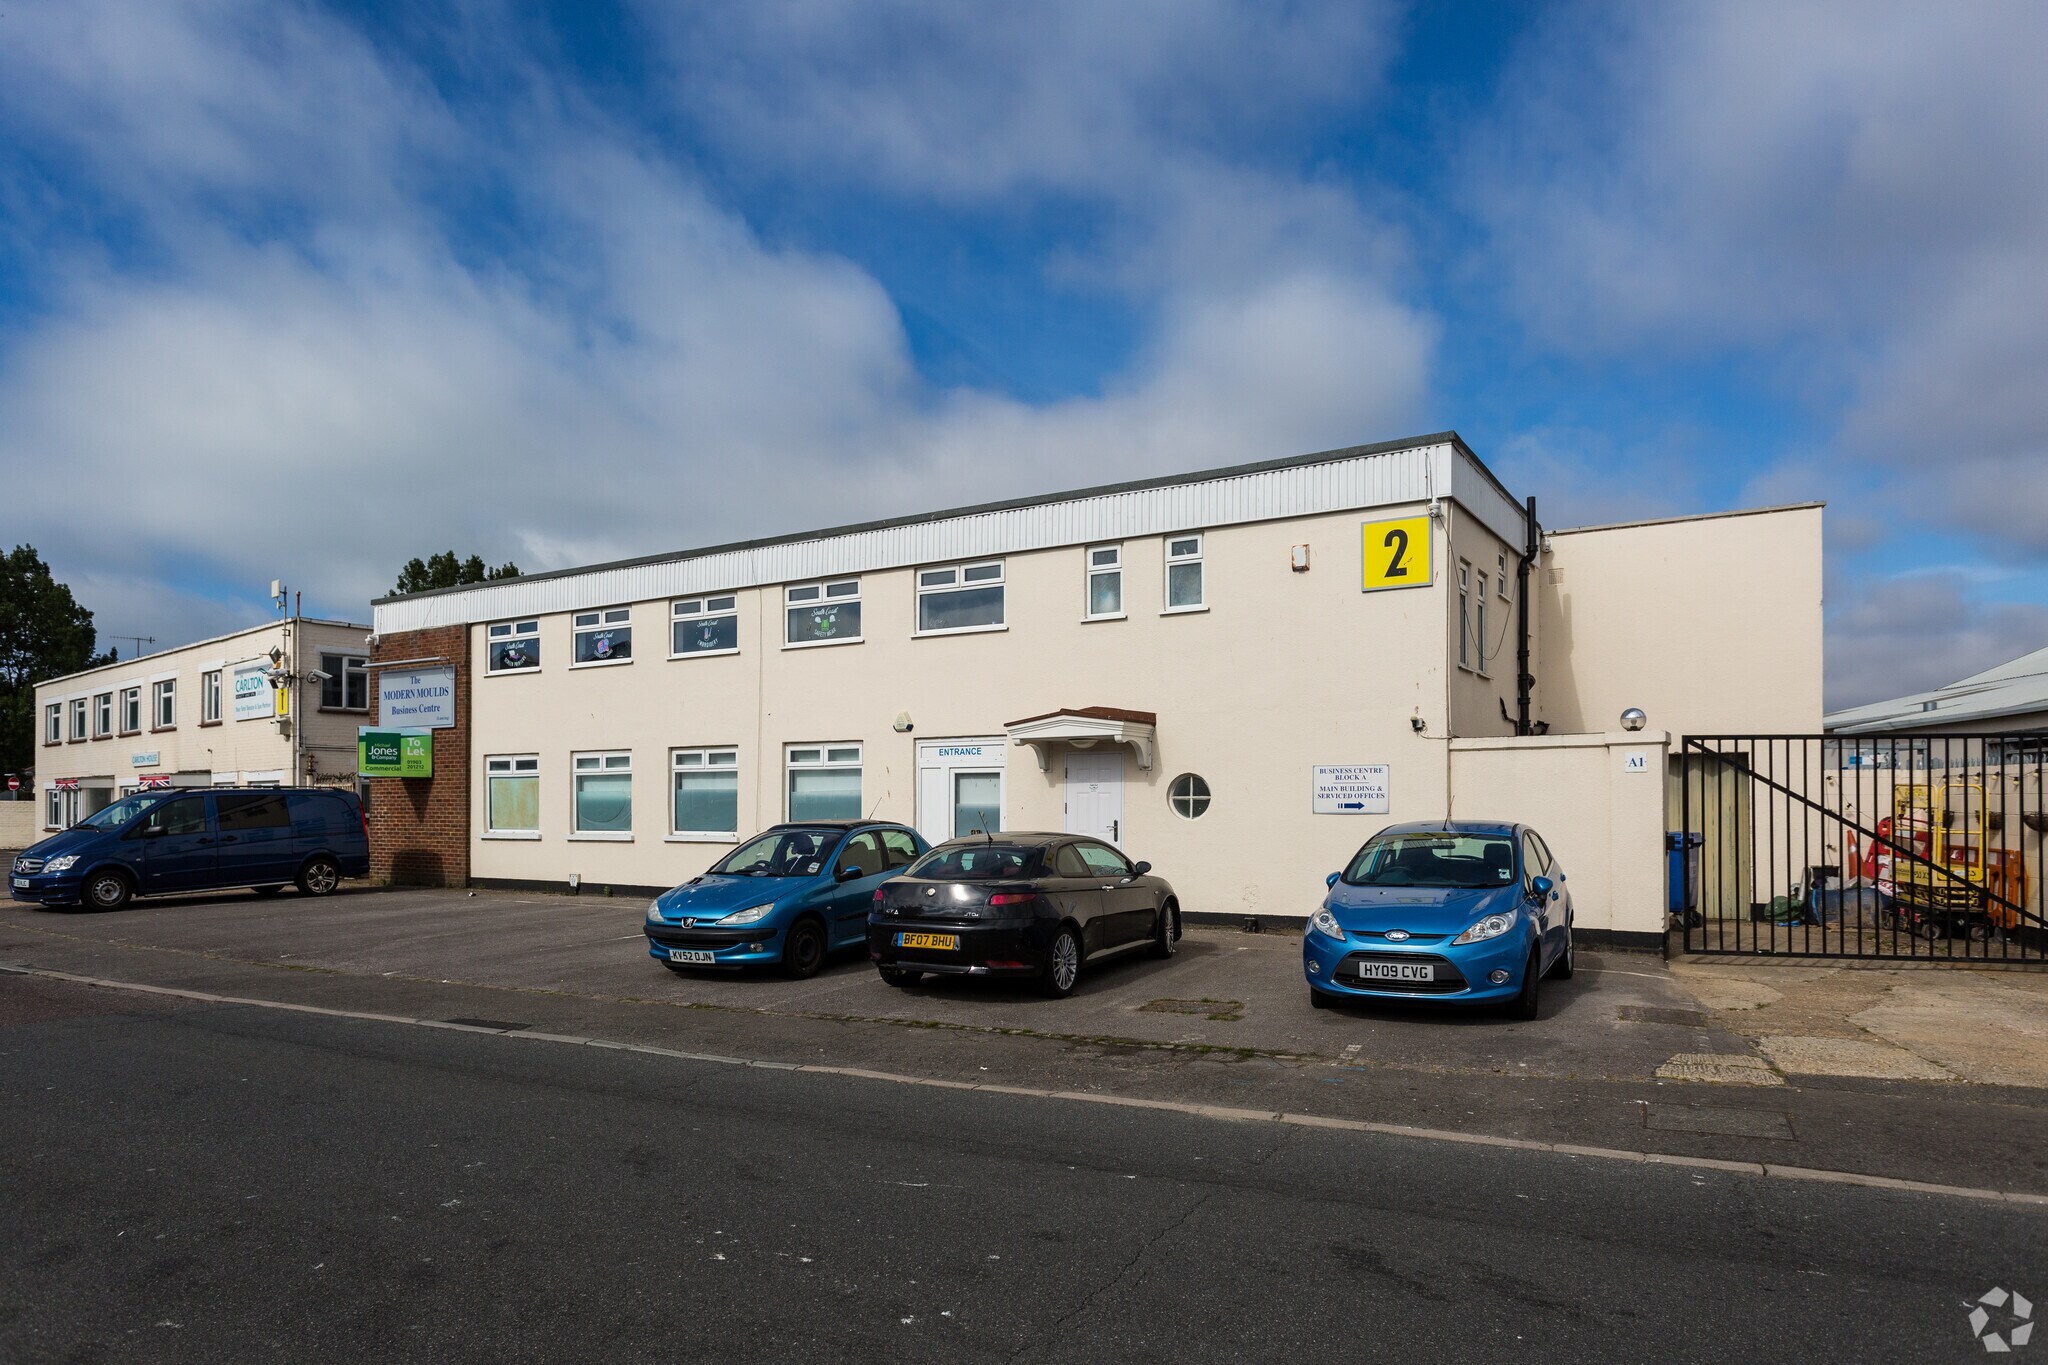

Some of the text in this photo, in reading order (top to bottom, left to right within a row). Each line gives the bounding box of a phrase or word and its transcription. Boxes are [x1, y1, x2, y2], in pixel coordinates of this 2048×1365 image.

[1384, 529, 1408, 578] 2
[236, 676, 264, 692] CARLTON
[410, 676, 421, 684] The
[384, 687, 449, 700] MODERN MOULDS
[392, 704, 440, 715] Business Centre
[406, 738, 420, 746] To
[368, 746, 398, 755] Jones
[407, 747, 425, 756] Let
[939, 747, 982, 756] ENTRANCE
[904, 934, 952, 947] BF07 BHU
[694, 952, 712, 961] OJN
[1364, 964, 1428, 978] HY09 CVG
